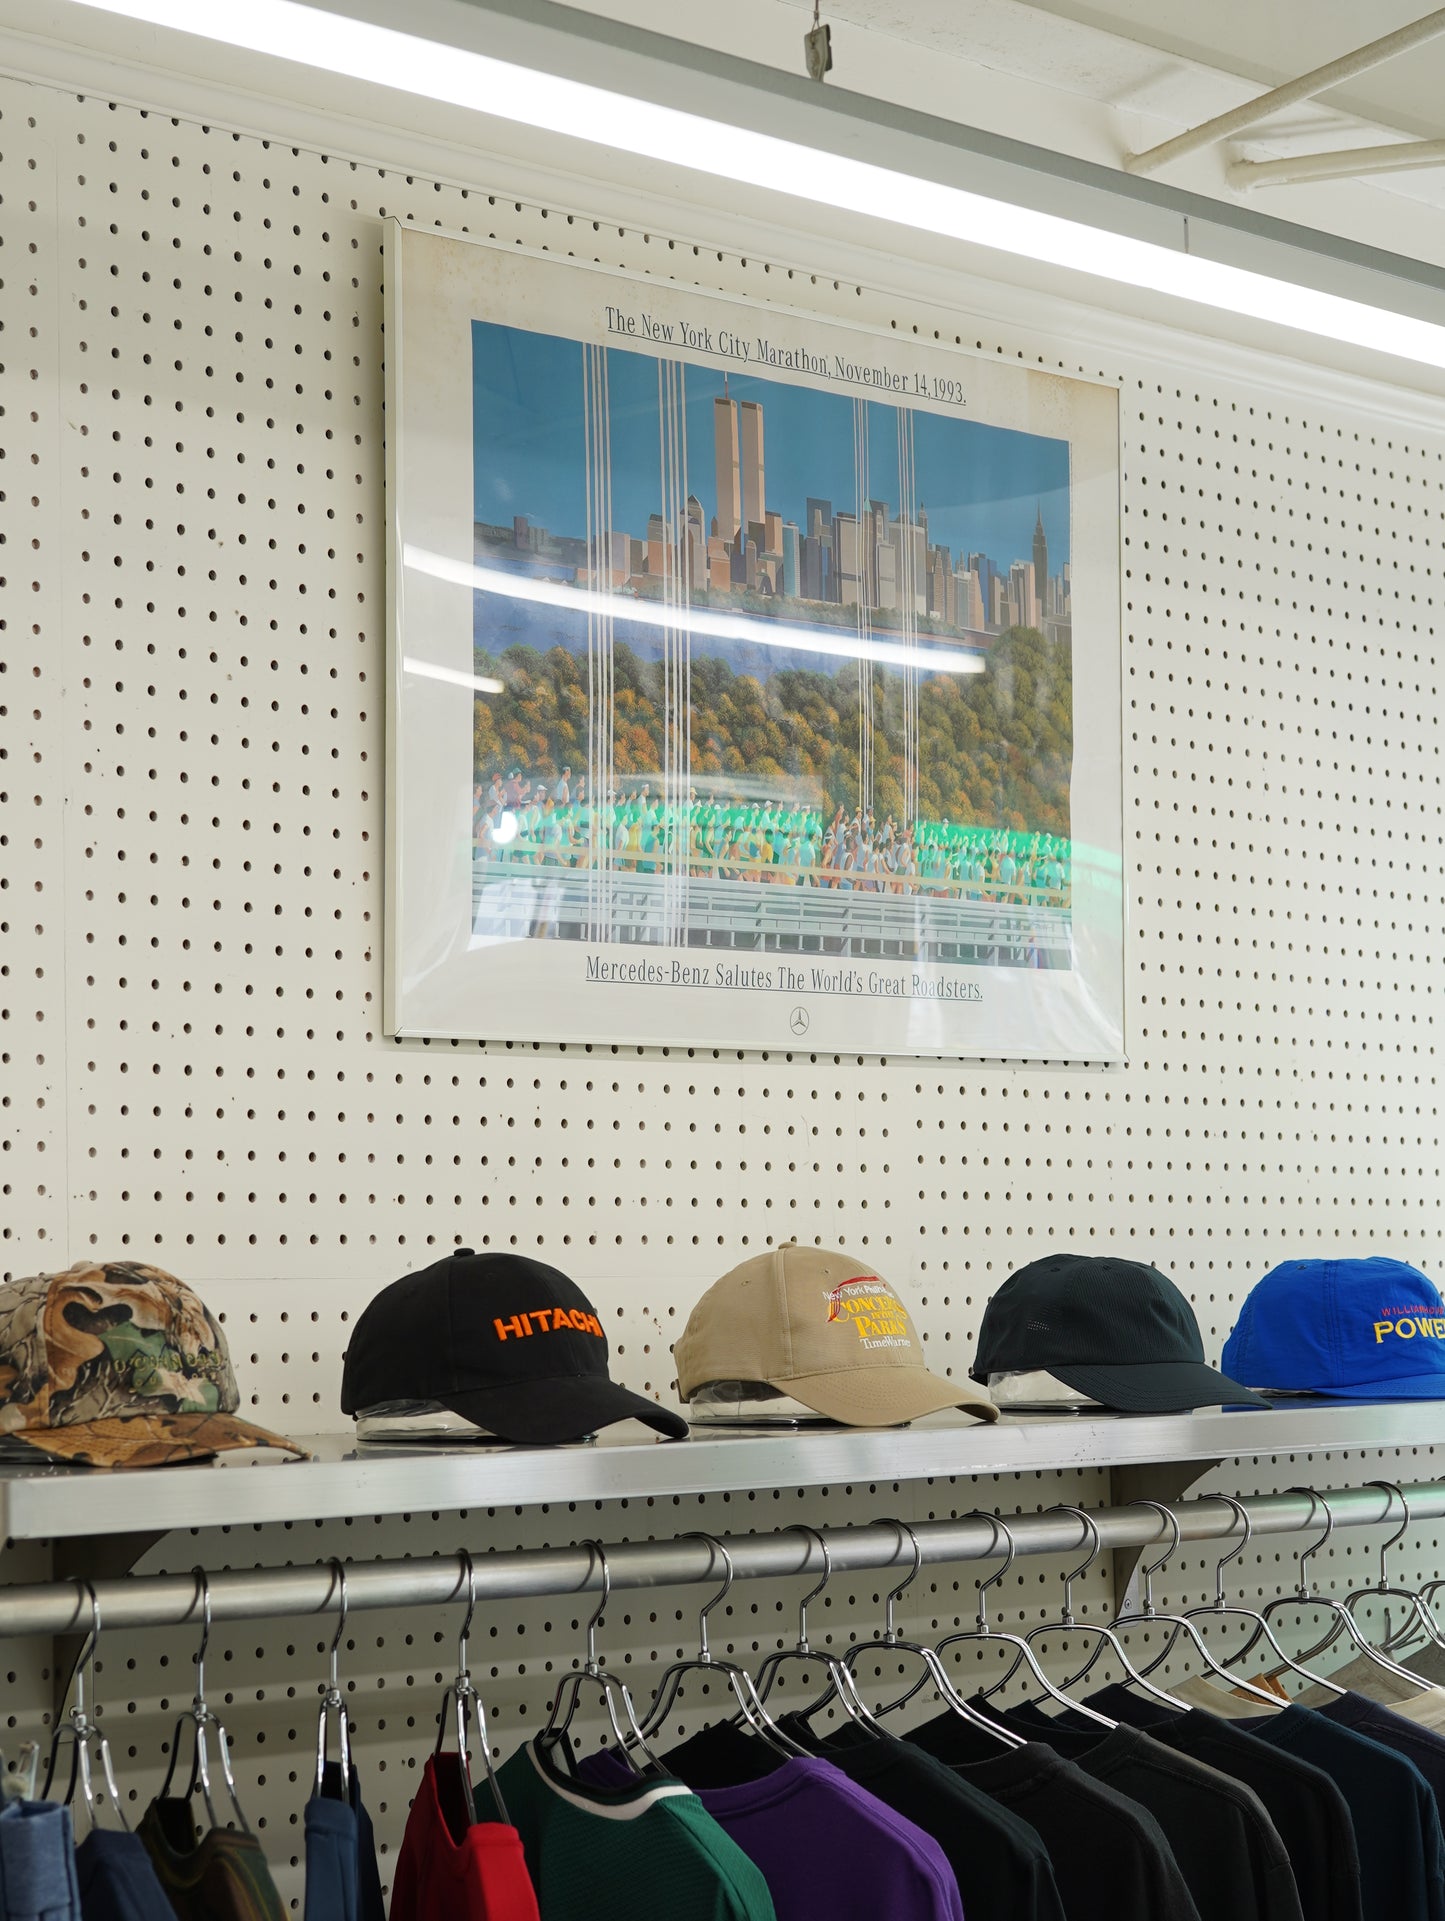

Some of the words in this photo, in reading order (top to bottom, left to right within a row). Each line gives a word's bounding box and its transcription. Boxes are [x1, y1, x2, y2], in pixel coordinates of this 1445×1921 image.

[605, 306, 635, 334] The
[641, 313, 674, 342] New
[679, 321, 713, 351] York
[718, 330, 751, 363] City
[757, 338, 832, 379] Marathon,
[835, 355, 909, 391] November
[585, 955, 710, 986] Mercedes-Benz
[715, 962, 772, 988] Salutes
[777, 966, 805, 990] The
[811, 968, 863, 993] World's
[869, 971, 906, 996] Great
[912, 974, 984, 1000] Roadsters.
[822, 1290, 843, 1301] New
[843, 1285, 865, 1297] York
[852, 1314, 907, 1338] PARKS
